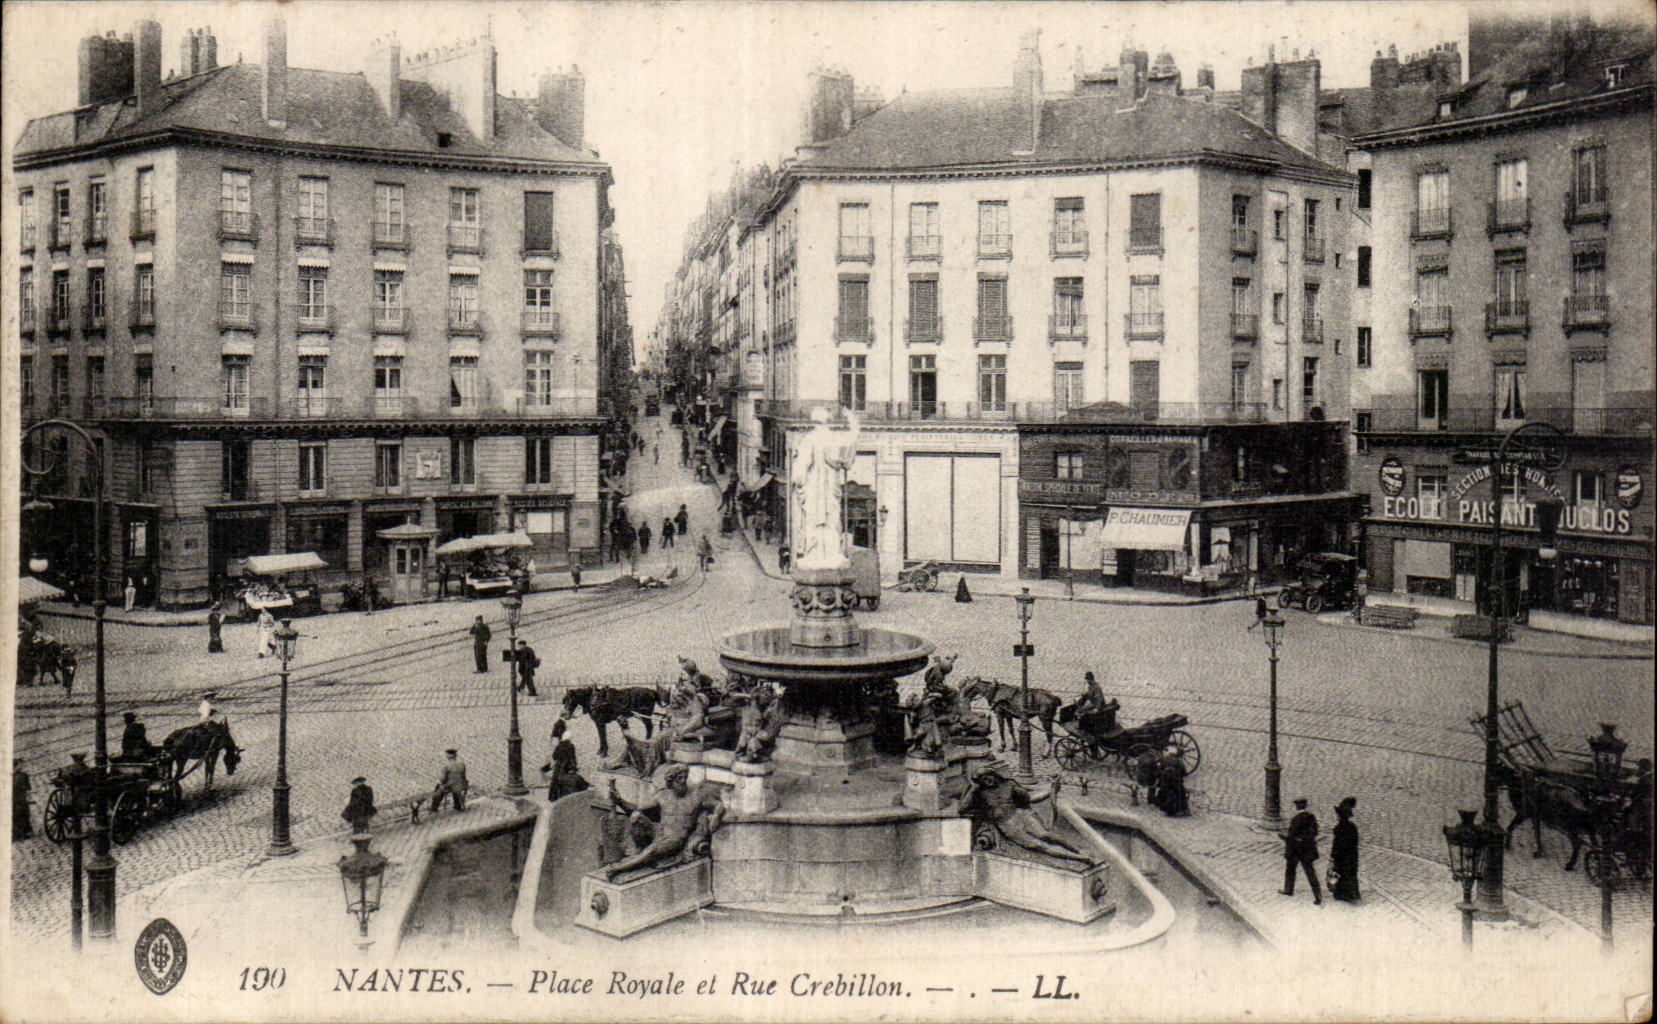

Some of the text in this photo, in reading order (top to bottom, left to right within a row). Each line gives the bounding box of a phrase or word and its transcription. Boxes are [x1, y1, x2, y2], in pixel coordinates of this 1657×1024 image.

[1451, 465, 1492, 500] SECTION
[1110, 490, 1195, 502] MODES
[1383, 496, 1442, 520] ECOLE
